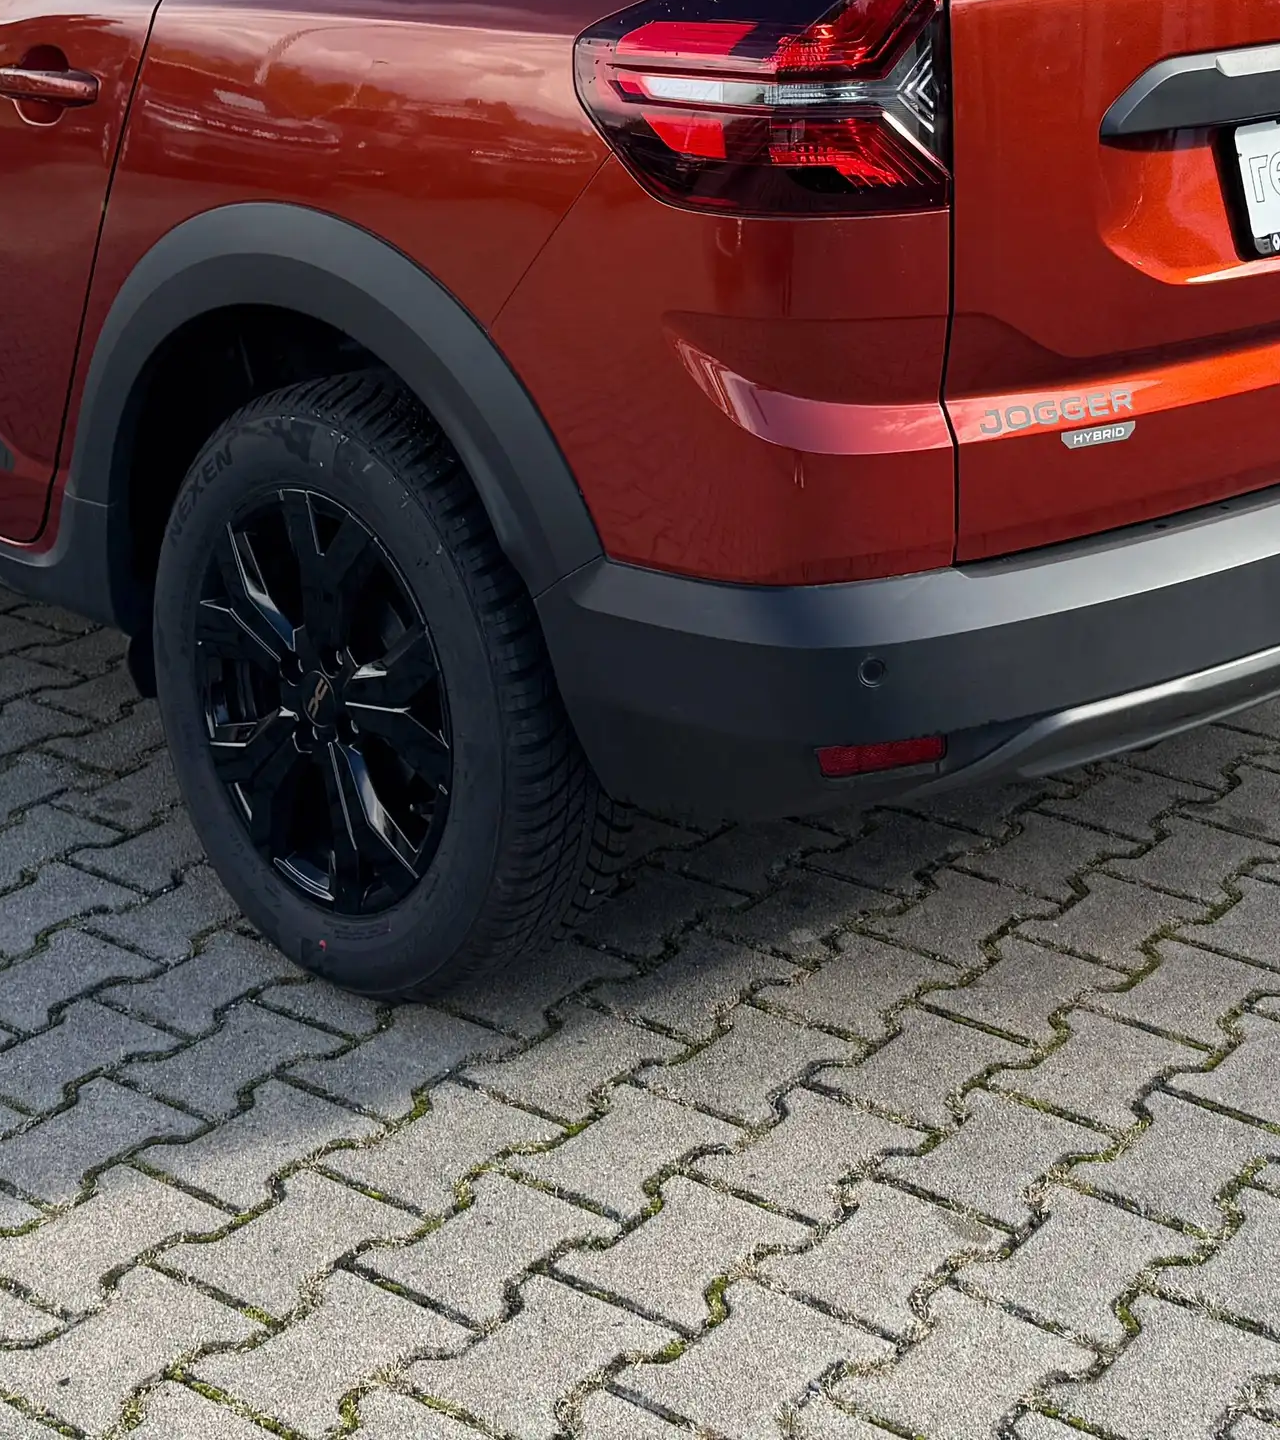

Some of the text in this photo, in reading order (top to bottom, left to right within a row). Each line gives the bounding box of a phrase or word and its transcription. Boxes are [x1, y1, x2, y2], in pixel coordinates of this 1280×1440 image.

[979, 388, 1133, 435] JOGGER
[1073, 426, 1125, 445] HYBRID
[169, 441, 234, 548] NEXEN
